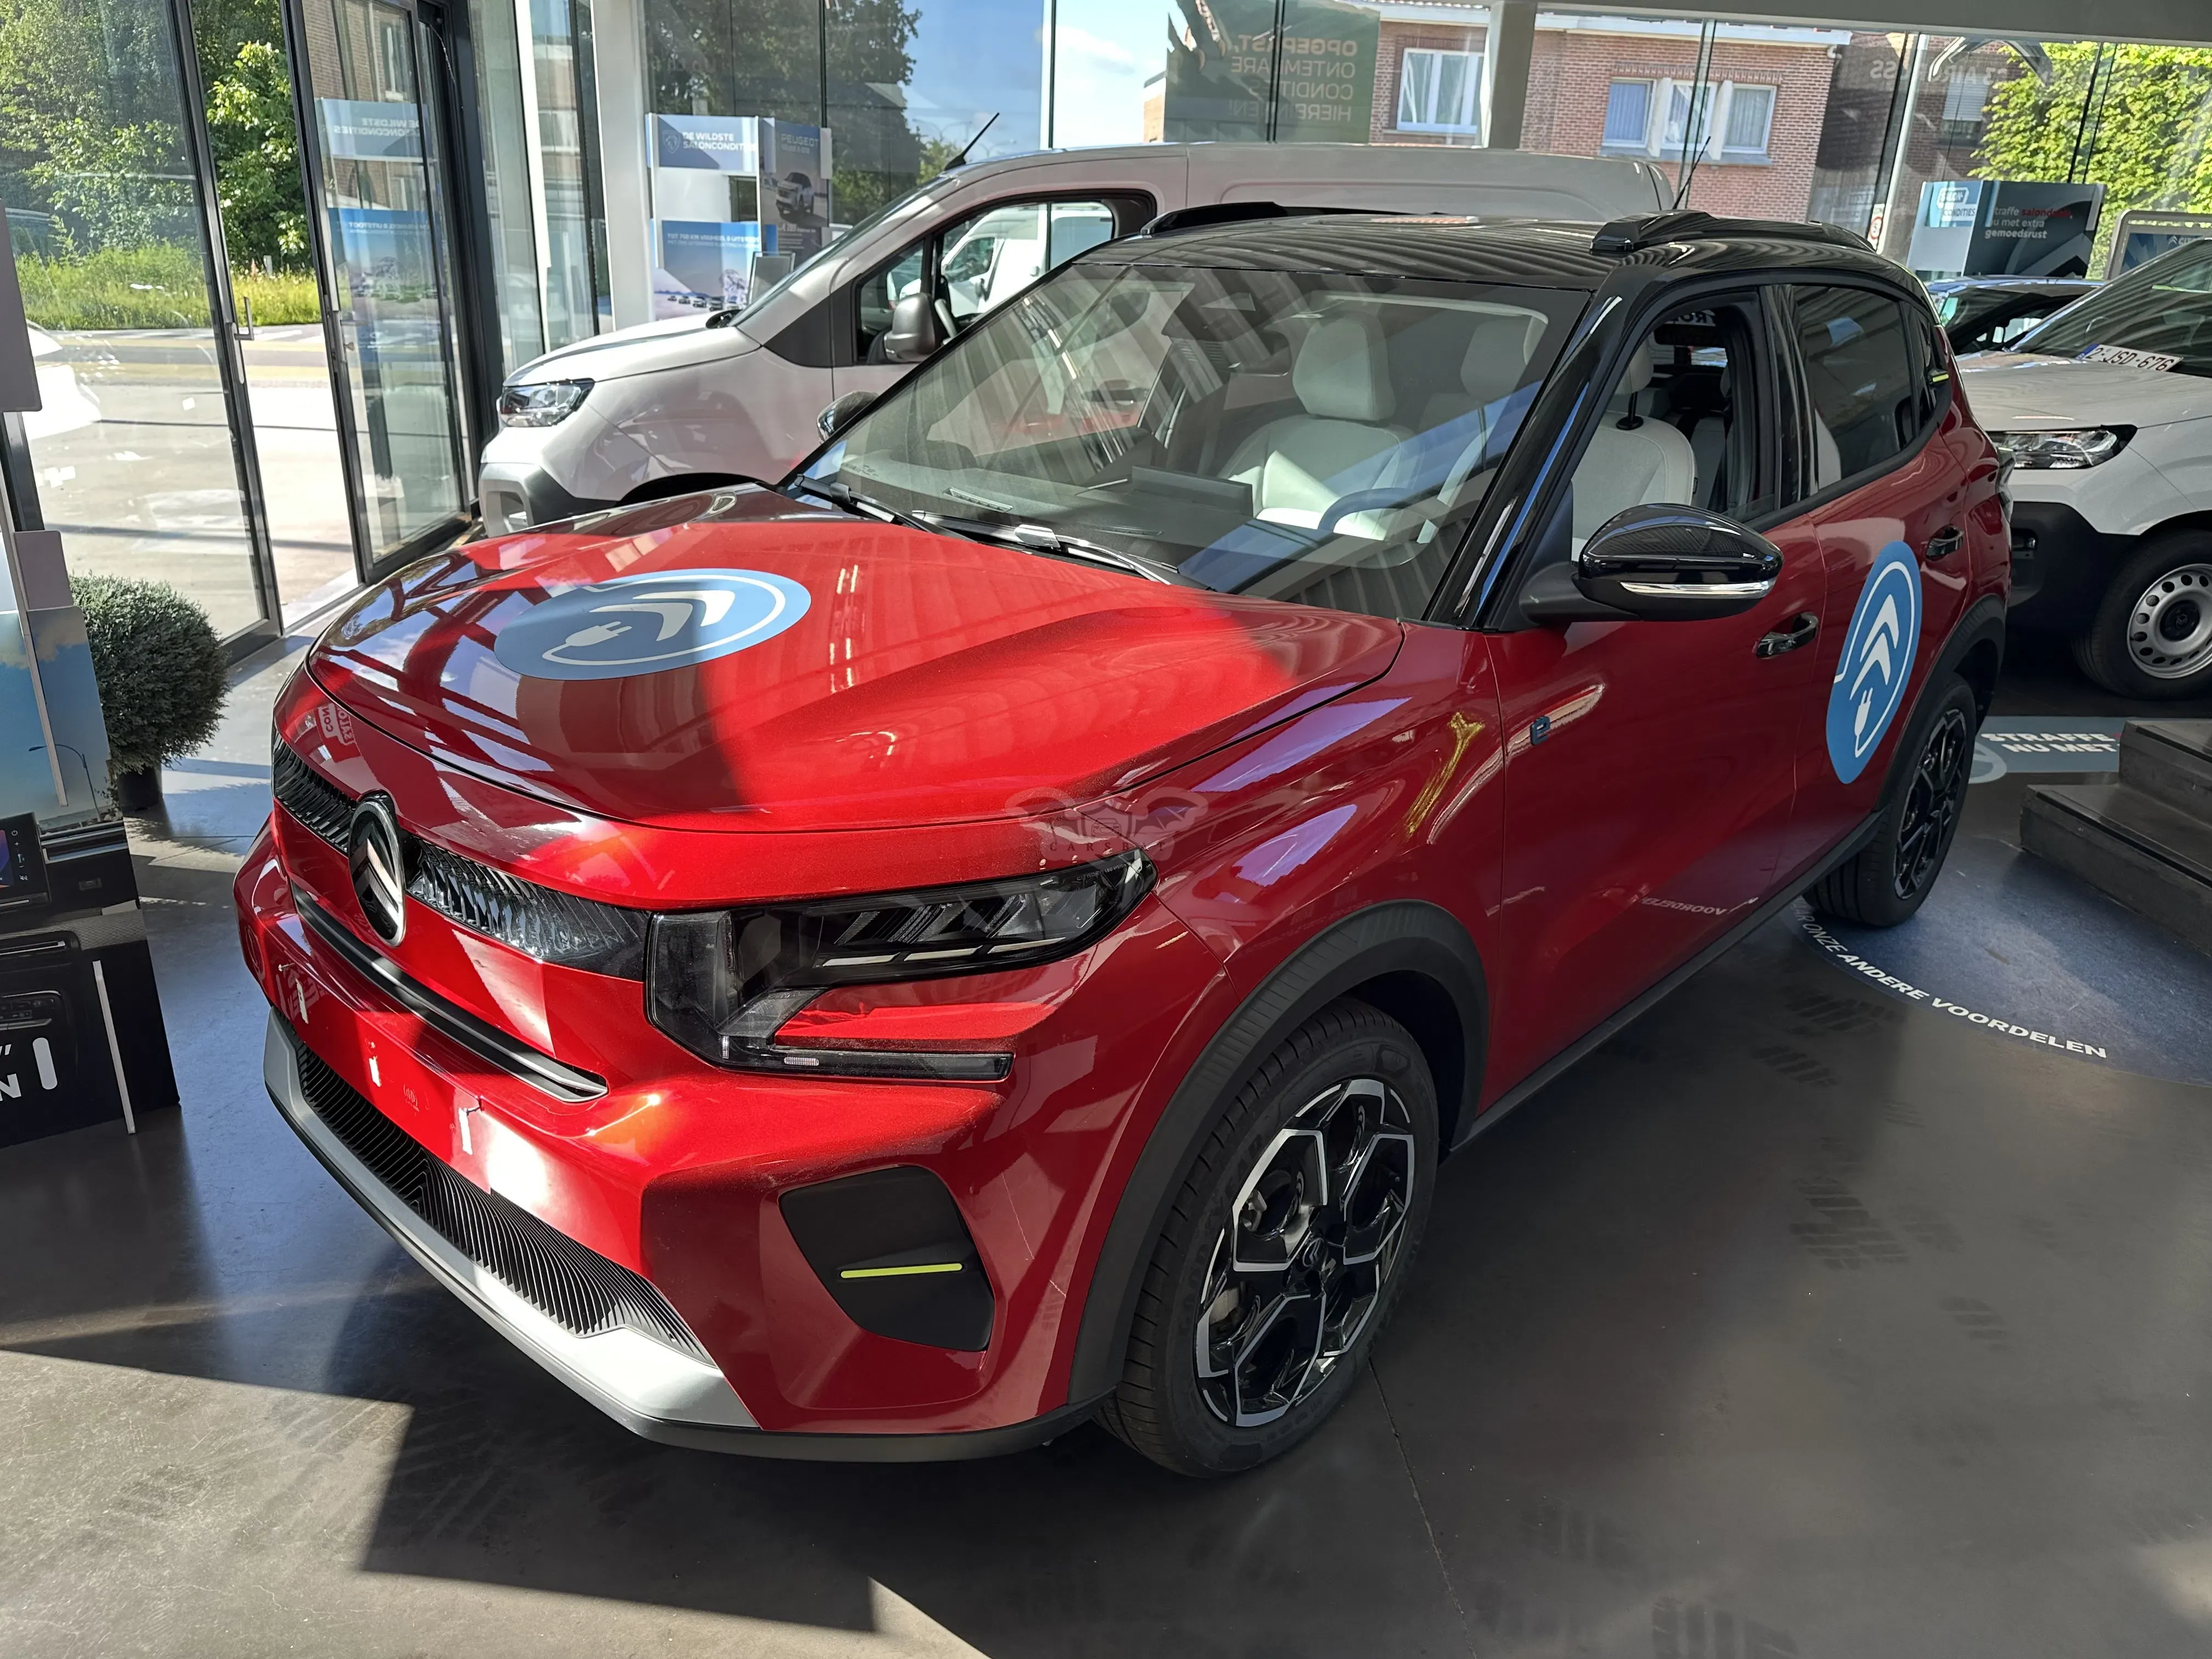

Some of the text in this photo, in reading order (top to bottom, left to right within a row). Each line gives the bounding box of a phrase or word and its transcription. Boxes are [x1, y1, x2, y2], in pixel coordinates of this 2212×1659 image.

[697, 132, 735, 142] WILDSTE
[780, 133, 819, 147] PEUGEOT
[2001, 218, 2020, 227] met
[2022, 219, 2045, 228] extra
[1984, 228, 2047, 239] gemoedsrust
[1980, 733, 2116, 742] STRAFFE
[2001, 743, 2117, 753] NU MET
[1803, 922, 1848, 952] ONZE
[1837, 953, 1930, 1000] ANDERE
[1931, 996, 2108, 1059] VOORDELEN
